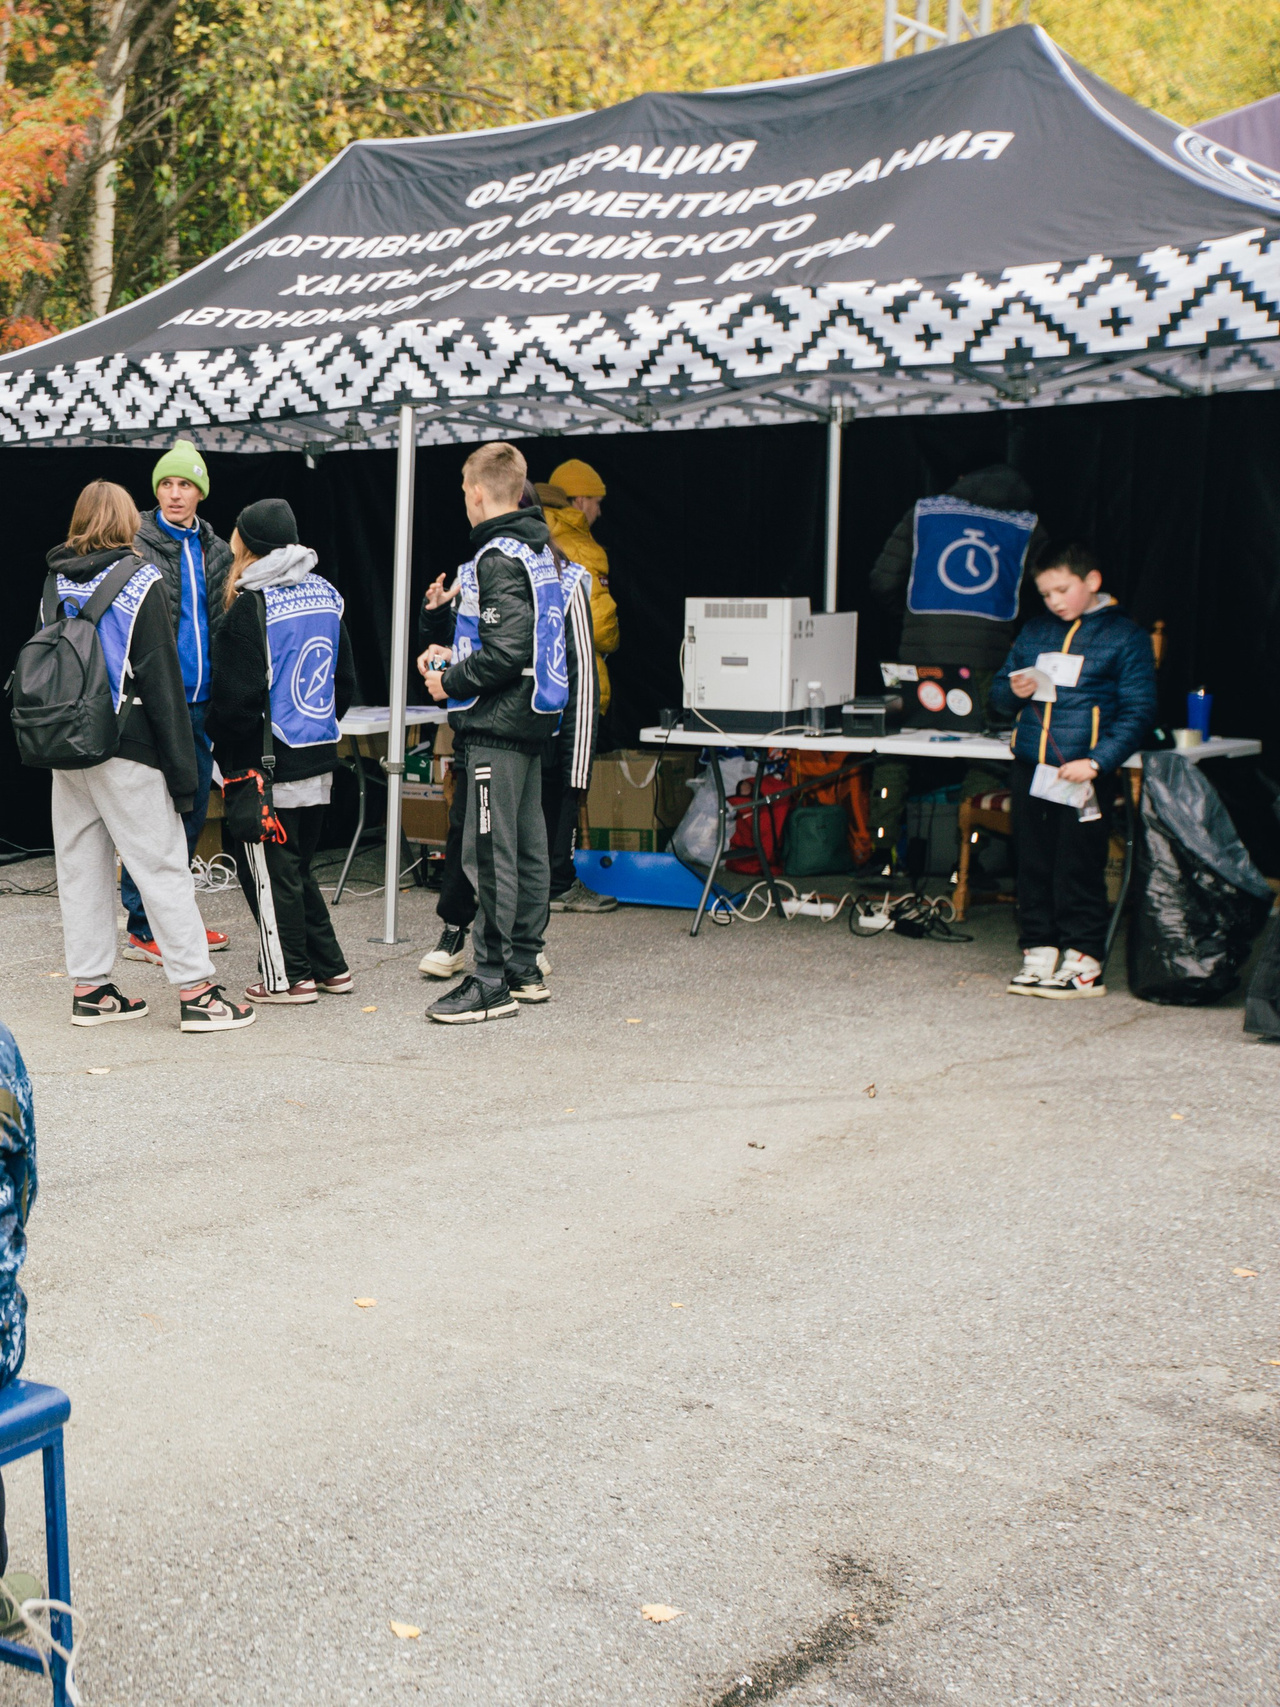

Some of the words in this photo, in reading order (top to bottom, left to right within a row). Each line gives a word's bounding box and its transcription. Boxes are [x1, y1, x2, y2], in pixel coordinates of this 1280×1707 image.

[223, 214, 513, 273] СПОРТИВНОГО
[514, 130, 1015, 229] ОРИЕНТИРОВАНИЯ
[465, 140, 758, 209] ФЕДЕРАЦИЯ
[157, 278, 468, 331] АВТОНОМНОГО
[468, 269, 662, 296] ОКРУГА
[714, 222, 896, 285] ЮГРЫ
[277, 213, 818, 298] ХАНТЫ-МАНСИЙСКОГО
